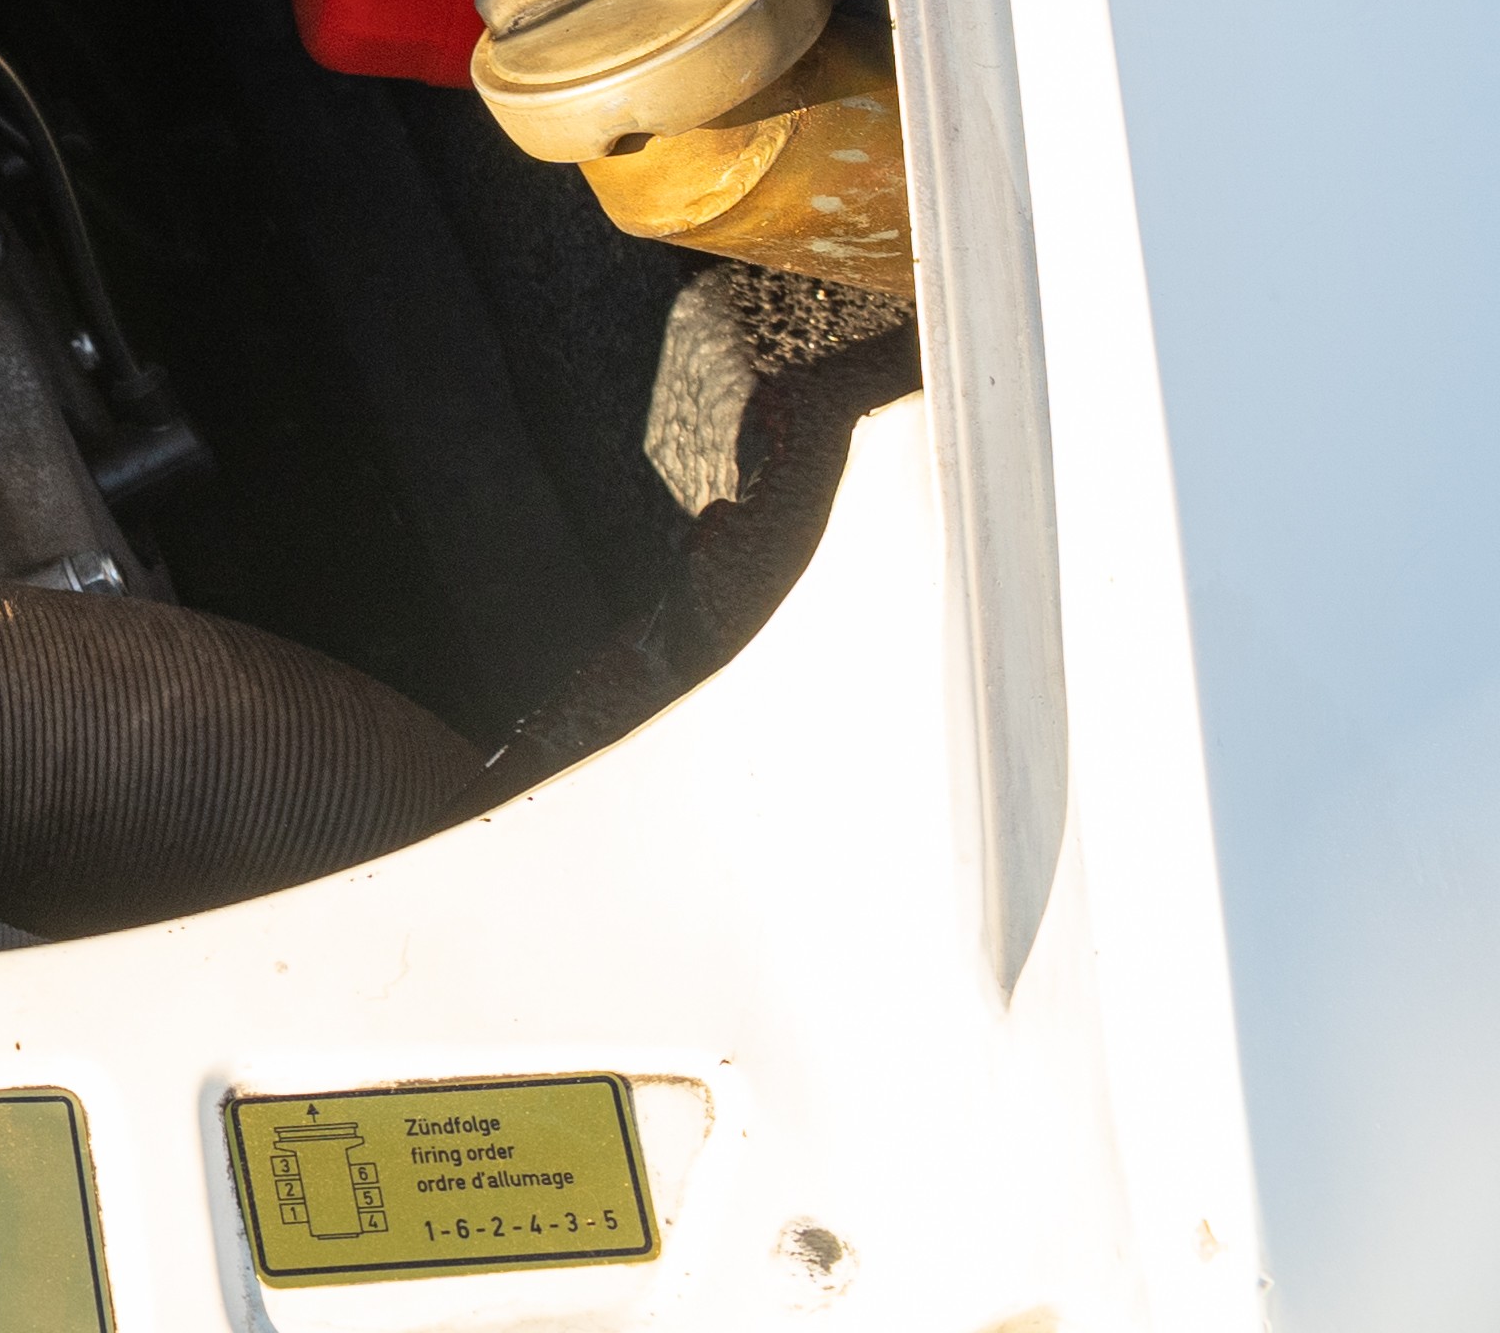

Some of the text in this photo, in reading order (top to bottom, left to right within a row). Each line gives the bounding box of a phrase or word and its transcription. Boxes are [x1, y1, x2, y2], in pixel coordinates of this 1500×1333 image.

[403, 1115, 501, 1137] Zündfolge
[410, 1143, 515, 1167] firing order
[280, 1159, 291, 1173] 3
[358, 1167, 368, 1181] 6
[416, 1170, 574, 1193] ordre d'allumage
[285, 1183, 295, 1196] 2
[363, 1191, 374, 1205] 5
[290, 1207, 297, 1221] 1
[368, 1215, 378, 1229] 4
